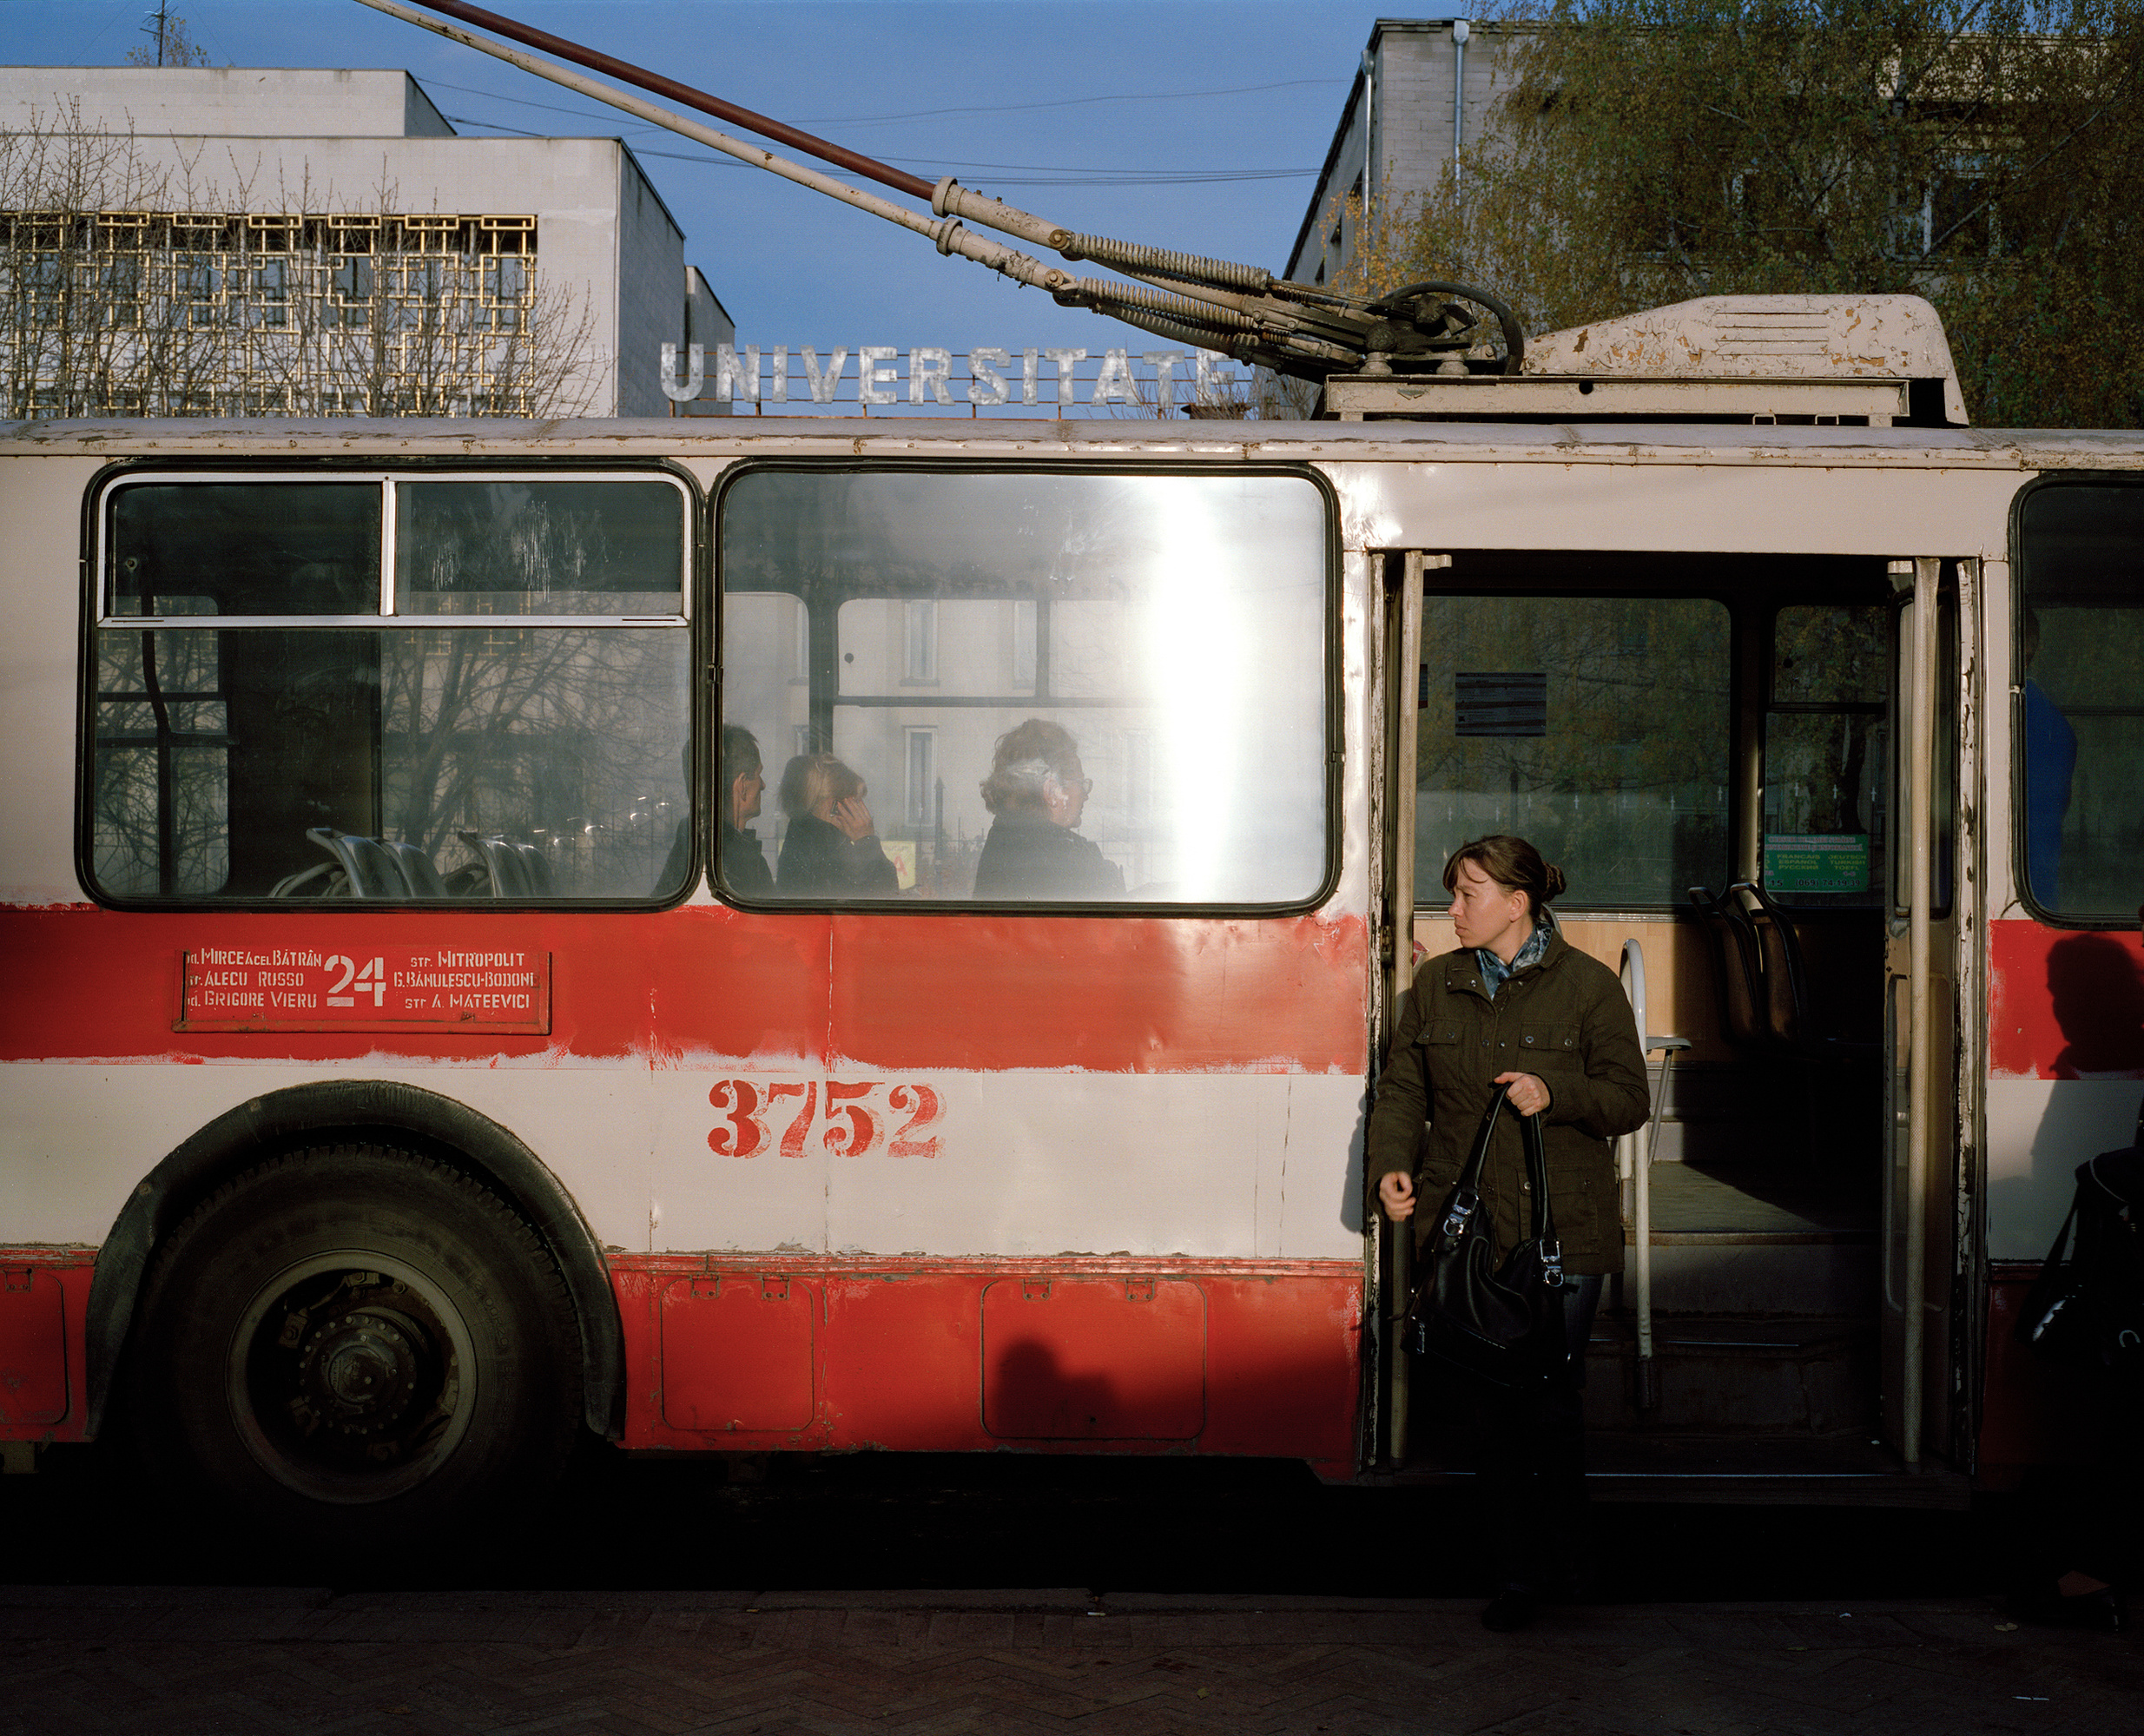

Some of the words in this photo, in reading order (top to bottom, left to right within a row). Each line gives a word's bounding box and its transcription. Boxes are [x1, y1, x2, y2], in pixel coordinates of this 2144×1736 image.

[438, 950, 524, 968] MITROPOLIT
[203, 971, 247, 987] ALECU
[259, 971, 304, 987] RUSSO
[323, 954, 386, 1007] 24
[204, 990, 265, 1007] GRIGORE
[270, 990, 318, 1008] VIERU
[449, 993, 530, 1009] MATEEVICI
[707, 1079, 947, 1158] 3752
